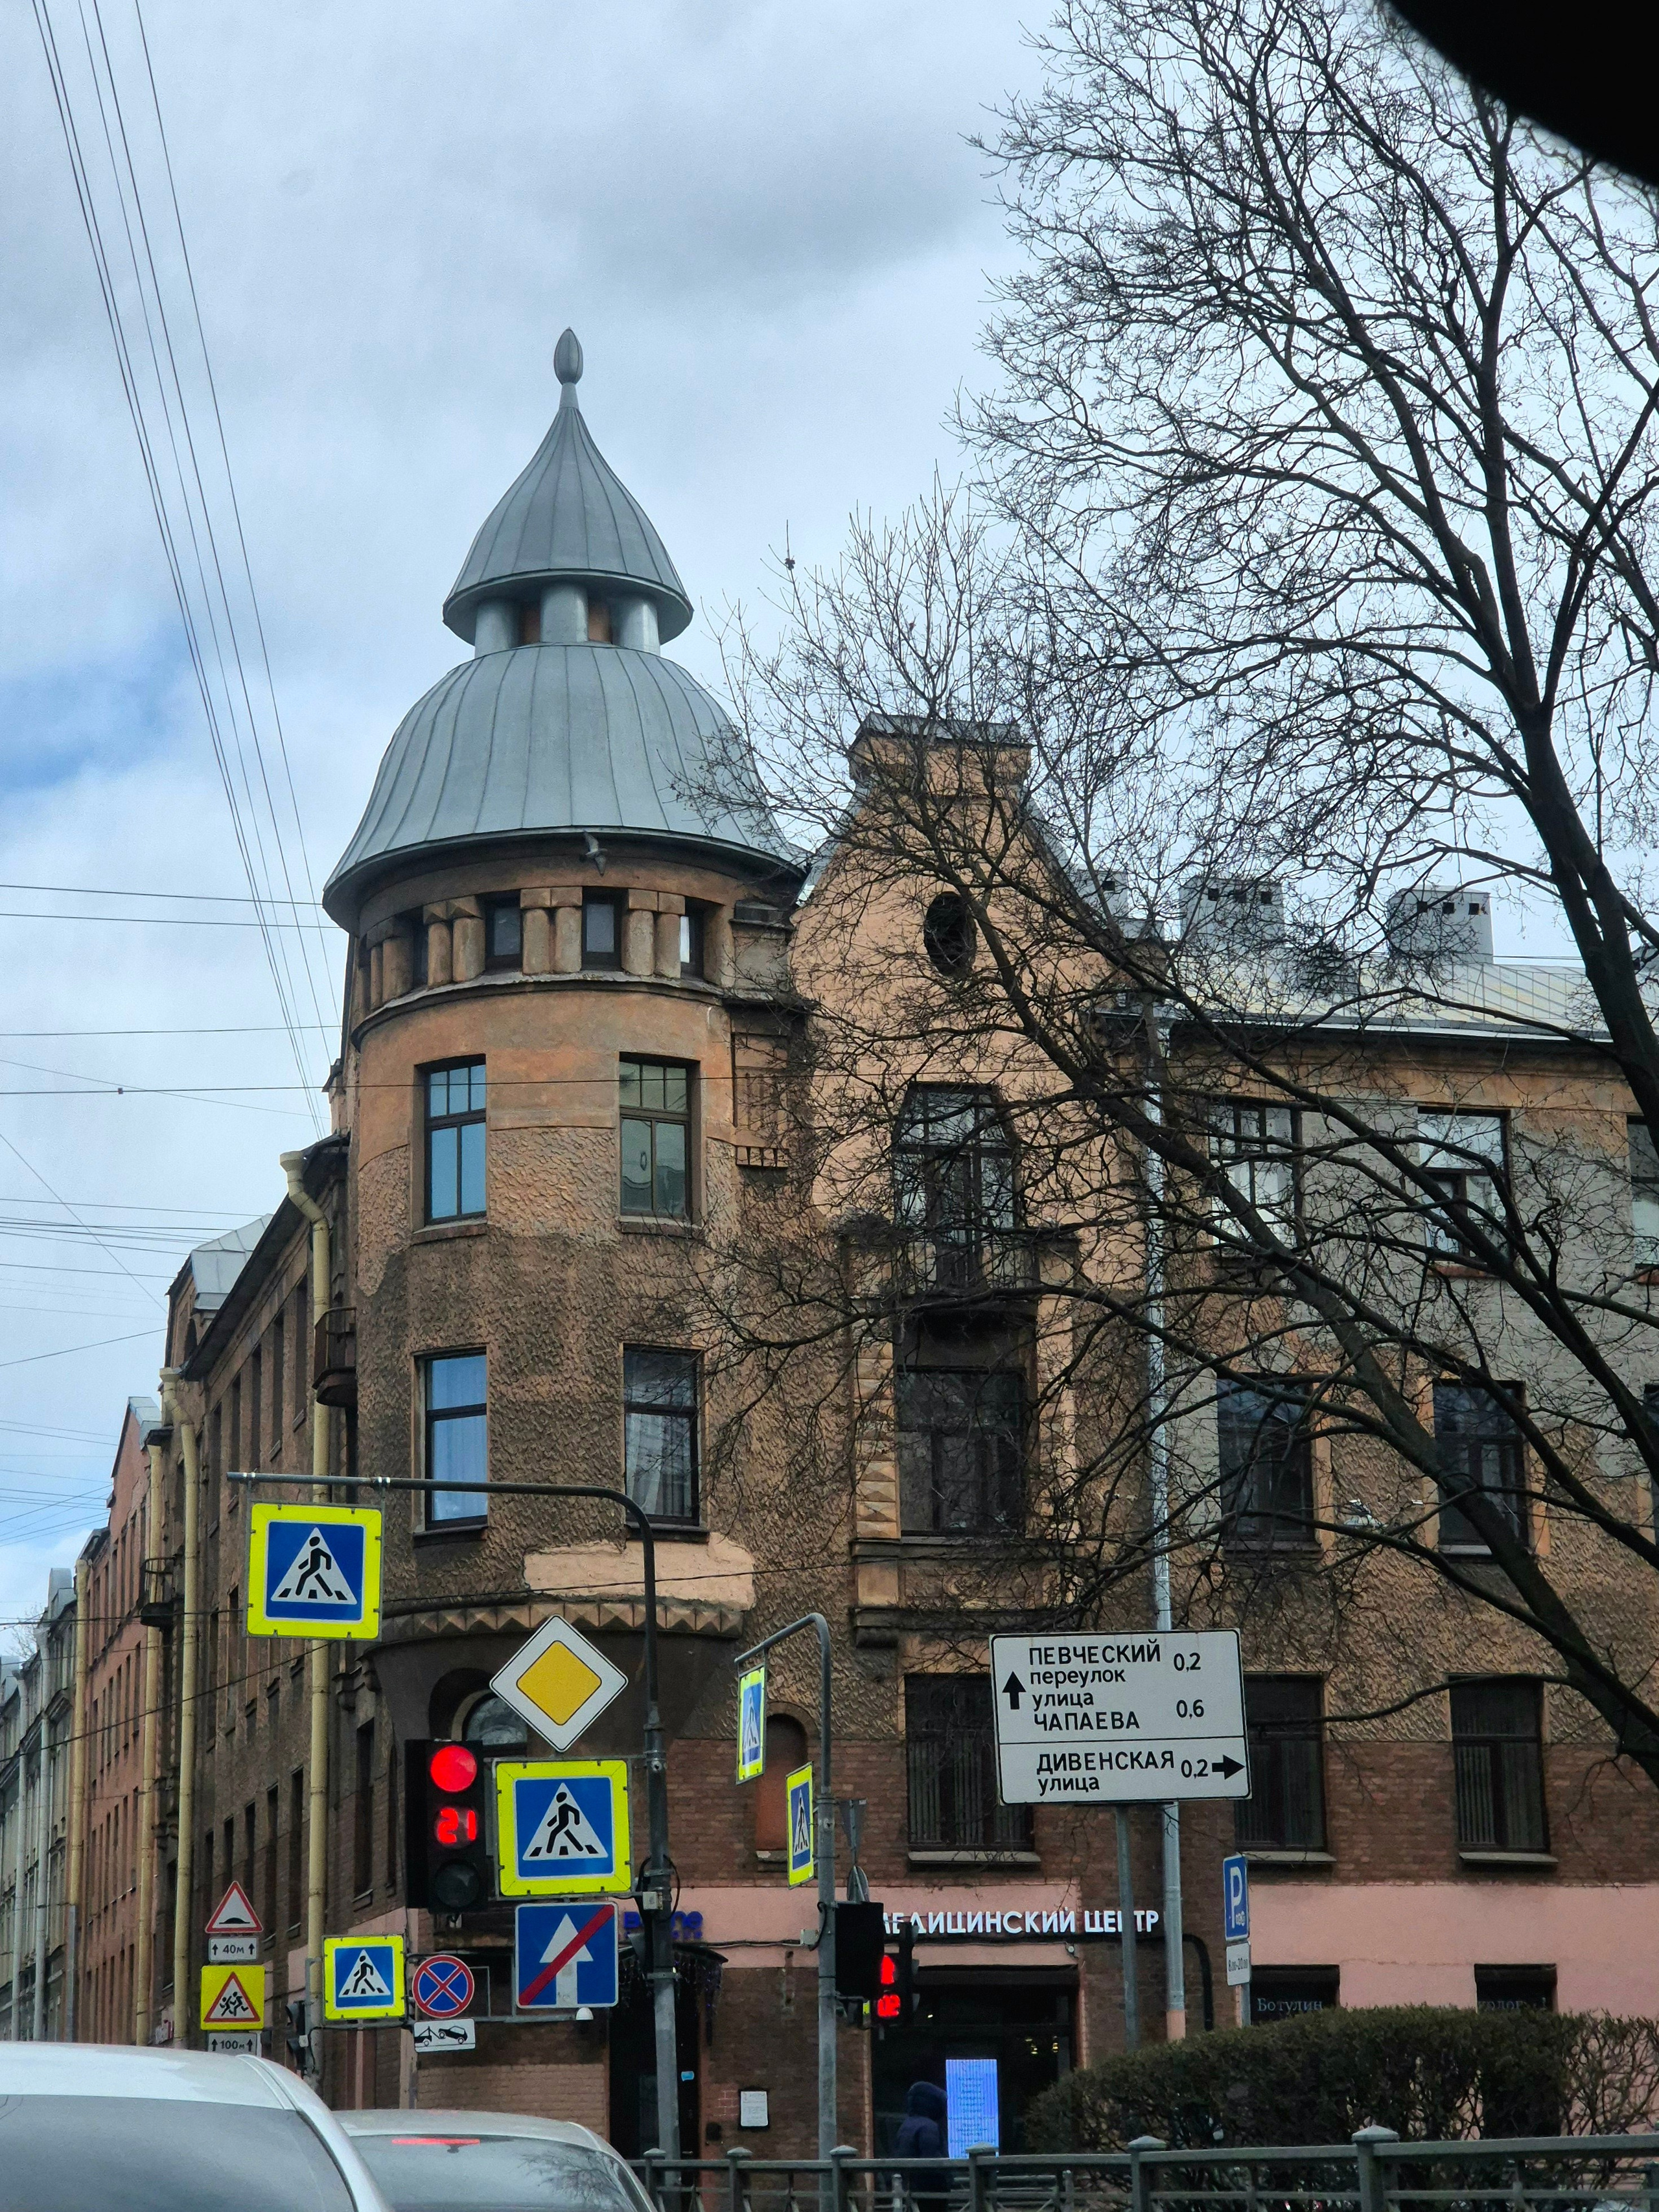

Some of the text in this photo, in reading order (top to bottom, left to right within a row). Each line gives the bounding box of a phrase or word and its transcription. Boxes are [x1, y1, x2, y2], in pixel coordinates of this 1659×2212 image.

[1029, 1638, 1201, 1673] ПЕВЧЕСКИЙ 0,2
[1030, 1669, 1126, 1689] переулок
[1032, 1692, 1205, 1719] улица 0,6
[1034, 1711, 1141, 1732] ЧАПАЕВА
[1036, 1750, 1209, 1780] ДИВЕНСКАЯ 0,2
[1038, 1776, 1100, 1797] улица
[437, 1806, 476, 1844] 21
[1084, 1910, 1159, 1933] ЦЕТР
[222, 1944, 245, 1954] 40м
[221, 2040, 245, 2050] 100м
